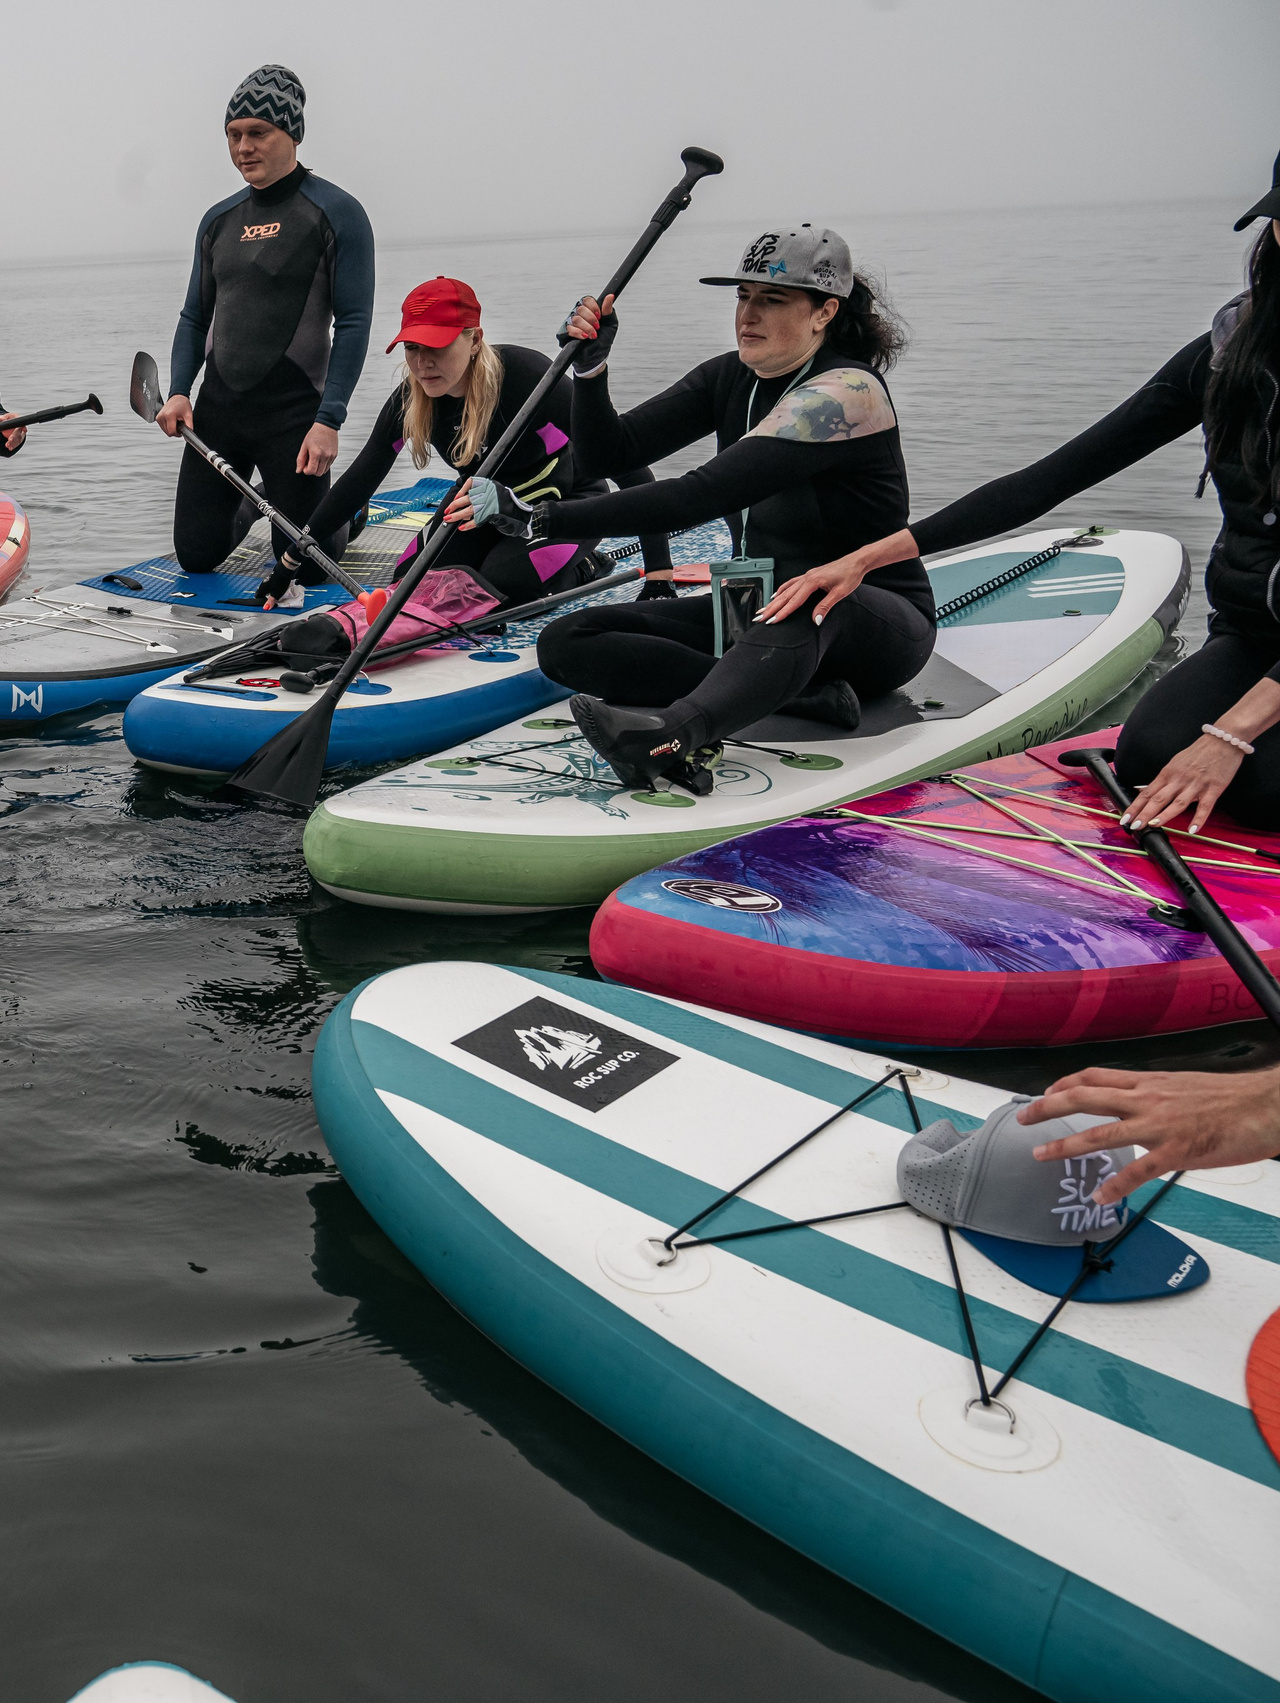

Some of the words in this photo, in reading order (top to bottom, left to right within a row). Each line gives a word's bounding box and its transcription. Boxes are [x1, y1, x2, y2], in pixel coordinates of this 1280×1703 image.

[241, 222, 281, 238] XPED
[747, 244, 776, 260] SUP
[742, 257, 770, 273] TIME
[986, 741, 1016, 761] M
[573, 1071, 603, 1089] ROC
[596, 1059, 621, 1075] SUP
[617, 1050, 641, 1062] CO.
[1057, 1172, 1118, 1204] SU
[1050, 1204, 1116, 1234] TIME
